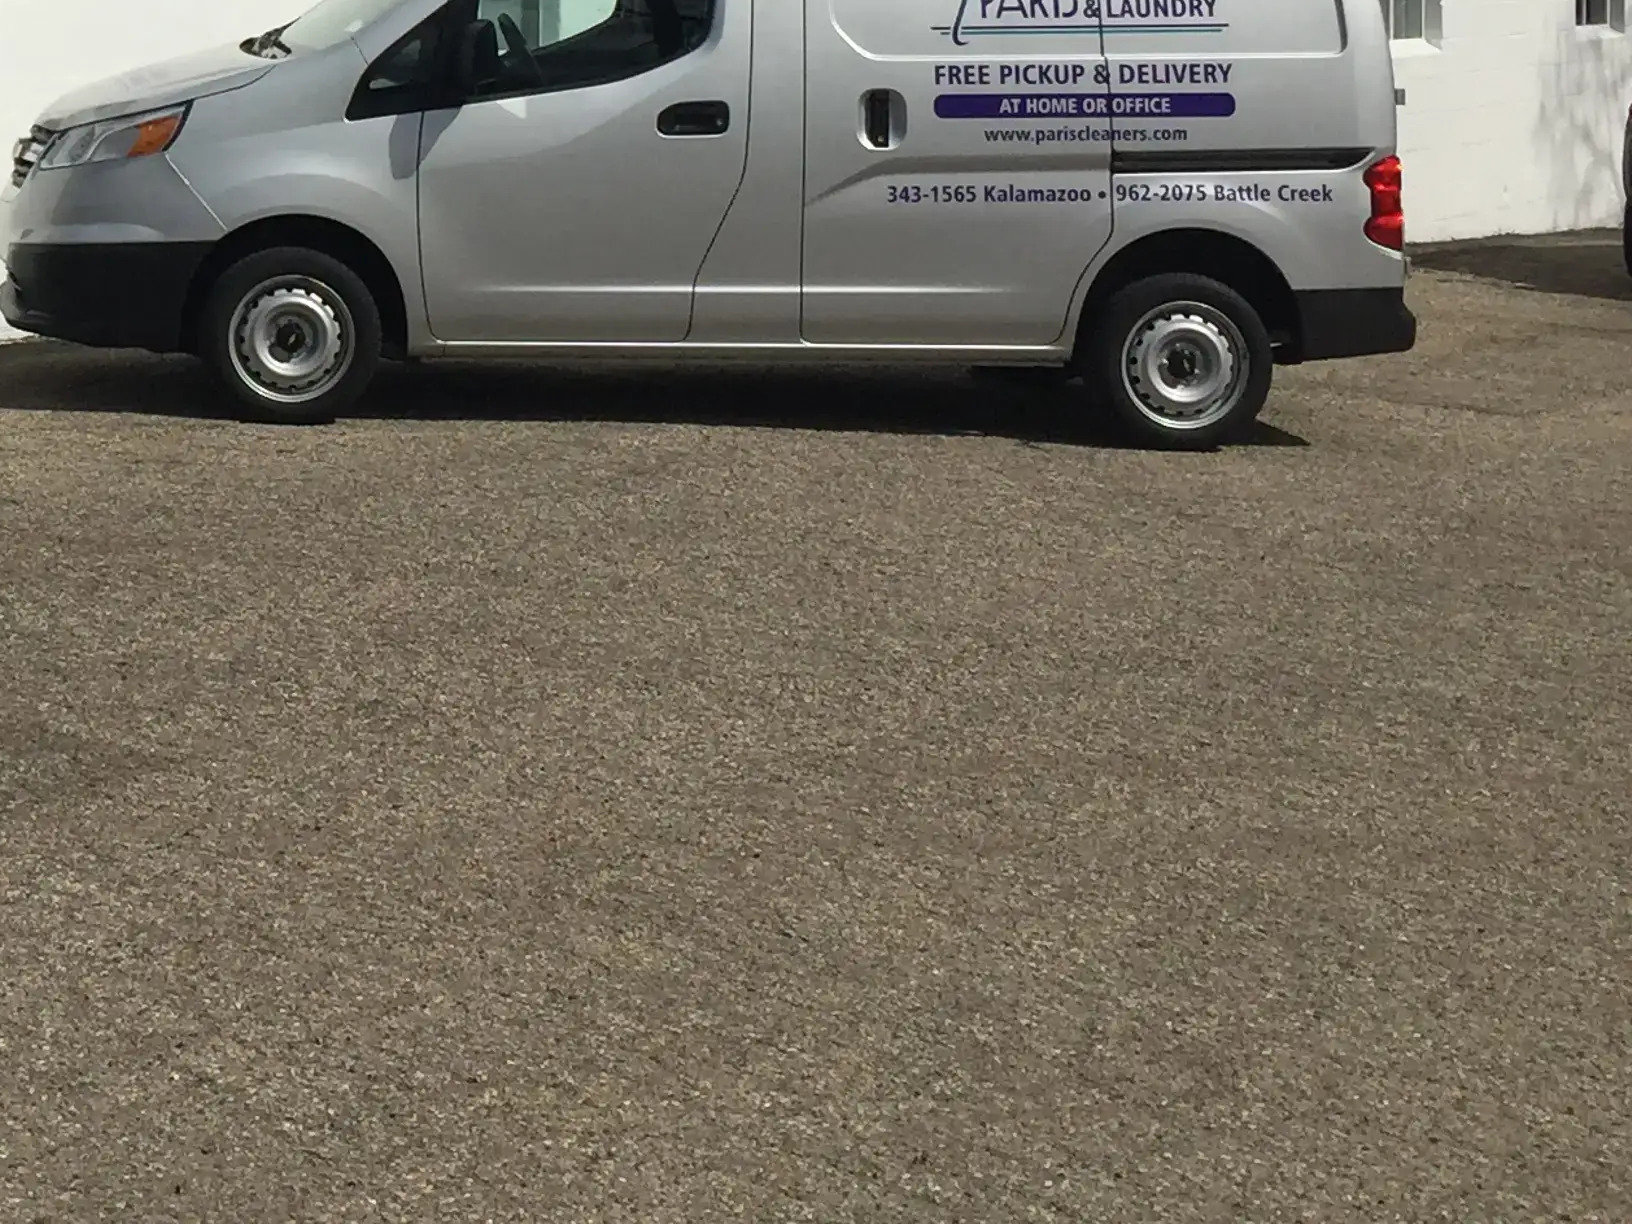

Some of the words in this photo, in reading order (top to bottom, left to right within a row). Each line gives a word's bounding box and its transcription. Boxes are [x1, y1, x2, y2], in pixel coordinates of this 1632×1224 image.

[934, 64, 990, 85] FREE
[999, 64, 1085, 85] PICKUP
[1093, 64, 1110, 85] &
[1119, 63, 1233, 85] DELIVERY
[999, 98, 1022, 114] AT
[1026, 98, 1077, 114] HOME
[1083, 97, 1107, 113] OR
[1112, 97, 1171, 114] OFFICE
[984, 126, 1188, 145] www.pariscleaners.com
[887, 184, 977, 203] 343-1565
[983, 184, 1091, 203] Kalamazoo
[1116, 184, 1207, 203] 962-2075
[1214, 184, 1271, 202] Battle
[1277, 183, 1334, 202] Creek
